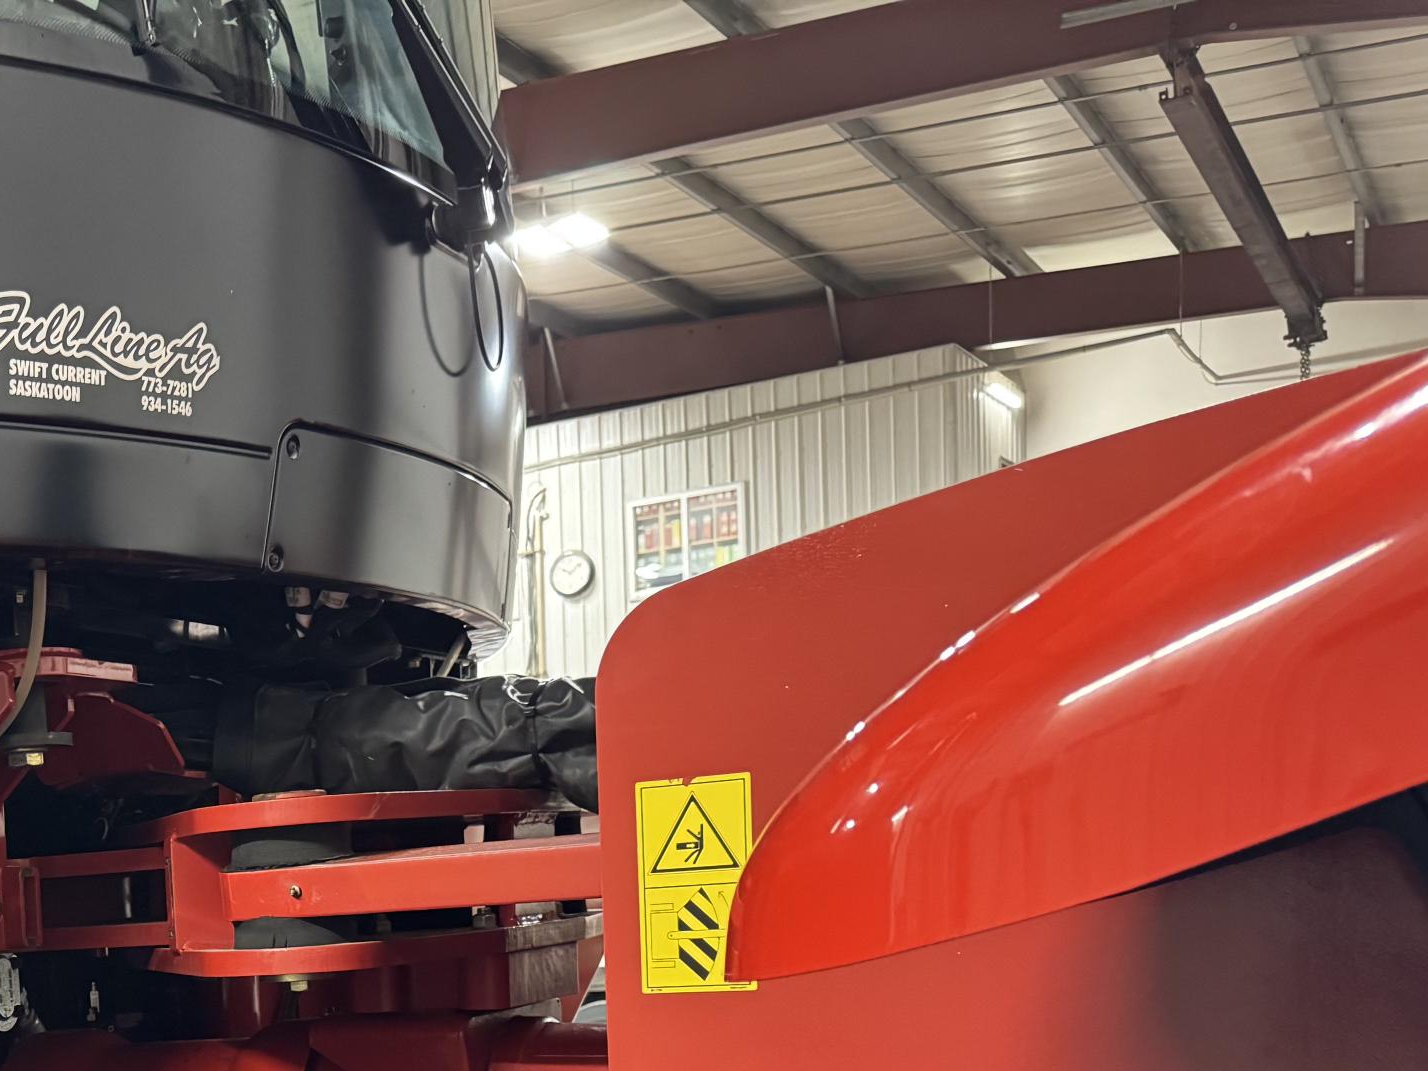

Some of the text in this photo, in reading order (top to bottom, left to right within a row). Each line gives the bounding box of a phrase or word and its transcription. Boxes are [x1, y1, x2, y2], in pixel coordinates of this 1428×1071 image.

[75, 305, 166, 380] Line
[154, 322, 221, 391] Ag
[9, 359, 107, 386] SWIFT CURRENT
[9, 379, 81, 402] SASKATOON
[141, 376, 193, 398] 773-7281
[141, 396, 193, 417] 934-1546
